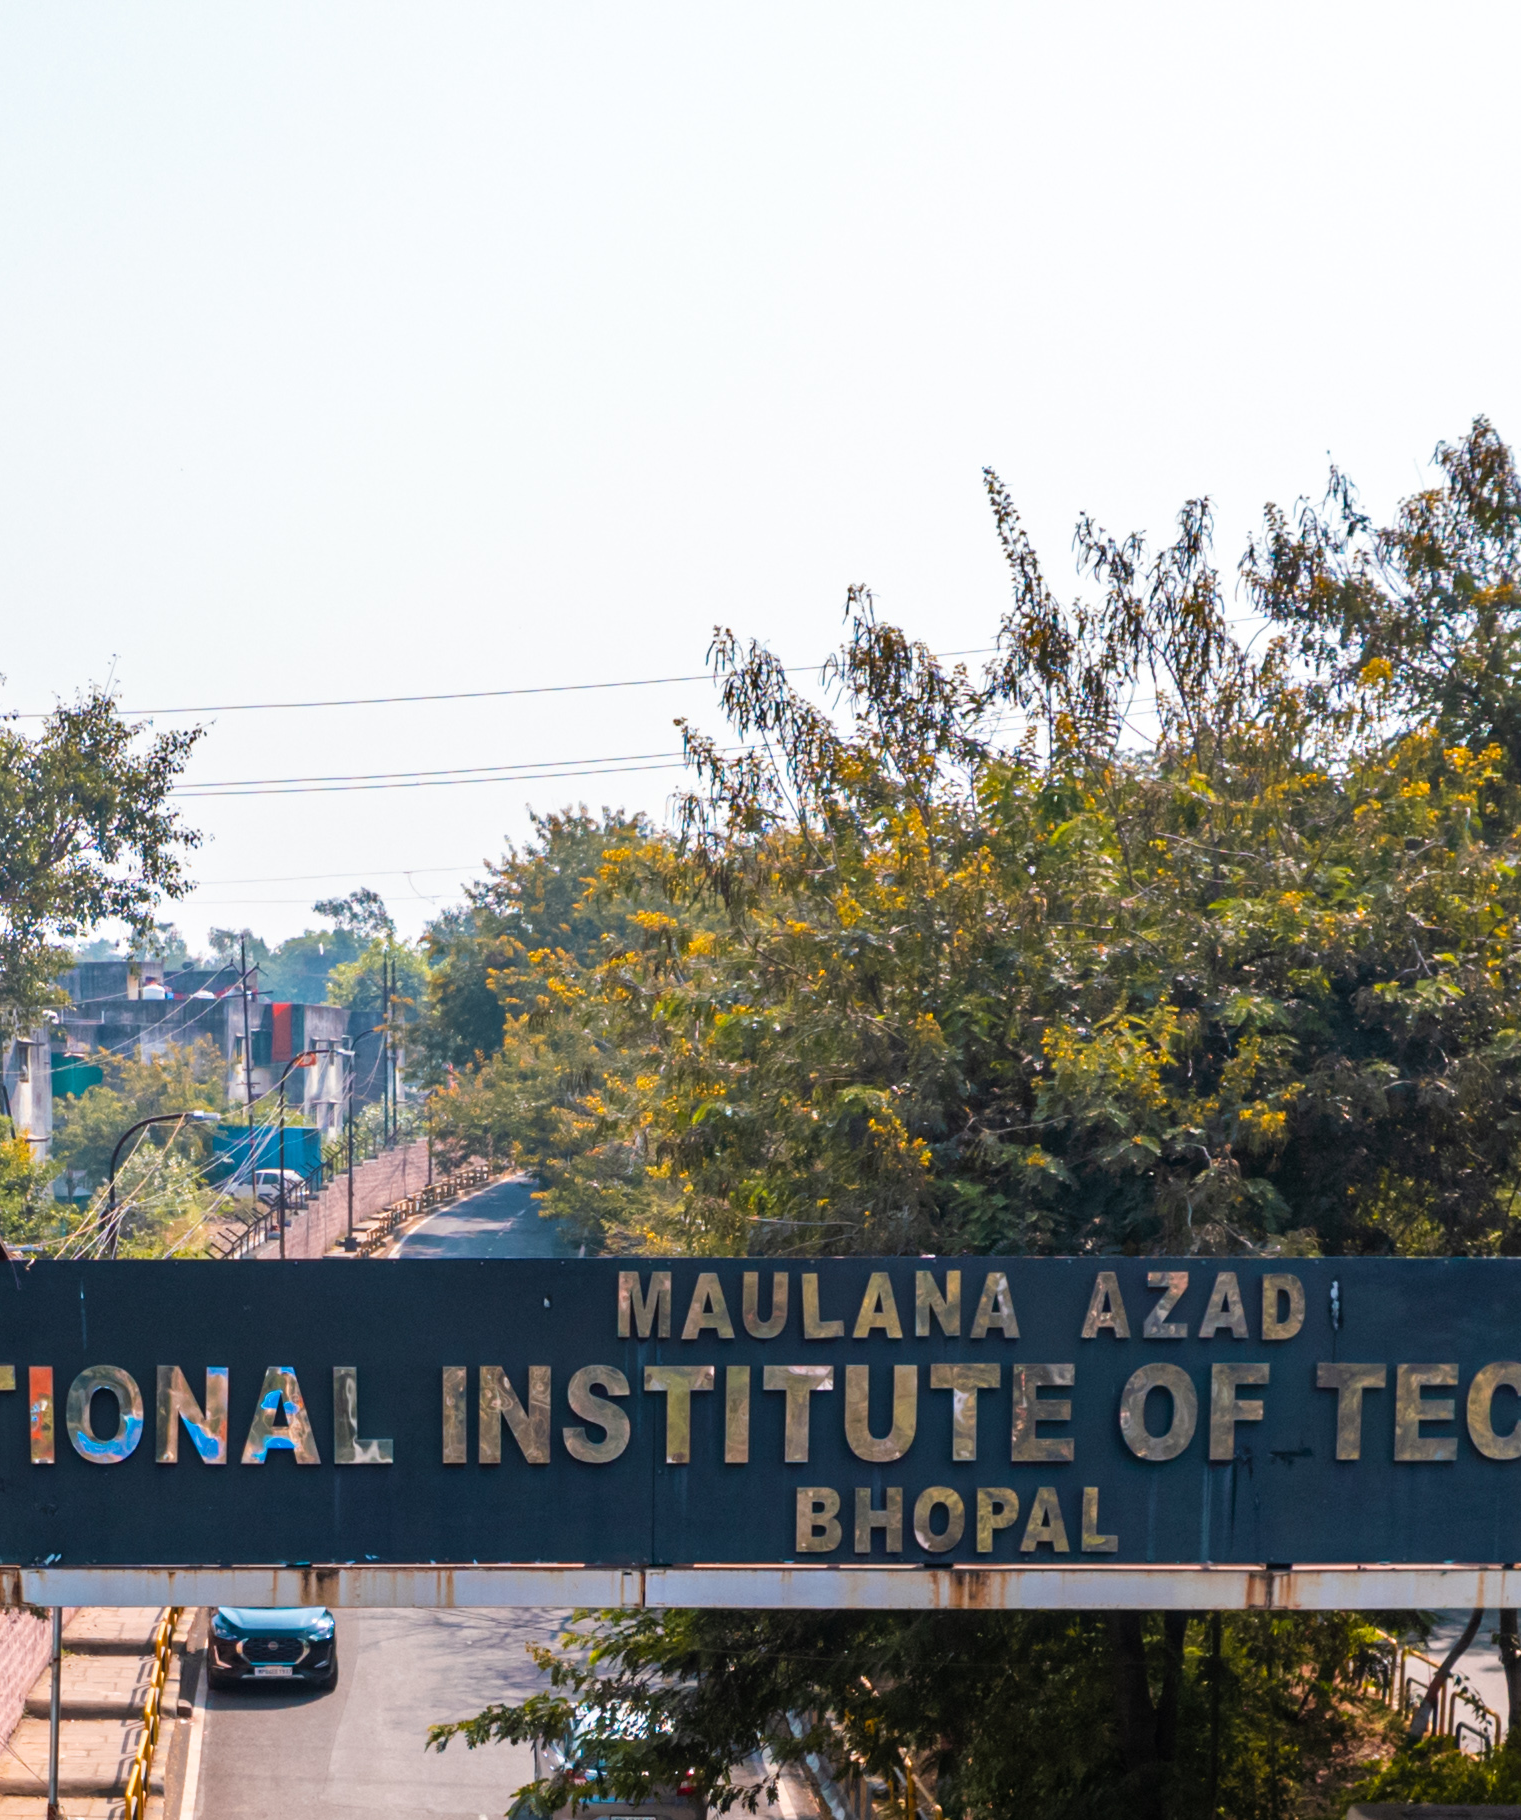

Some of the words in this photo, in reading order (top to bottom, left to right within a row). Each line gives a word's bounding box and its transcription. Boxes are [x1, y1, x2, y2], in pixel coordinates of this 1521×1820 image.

[616, 1270, 1021, 1341] MAULANA
[1080, 1270, 1307, 1341] AZAD
[442, 1362, 1076, 1465] INSTITUTE
[1118, 1362, 1271, 1462] OF
[795, 1486, 1119, 1554] BHOPAL
